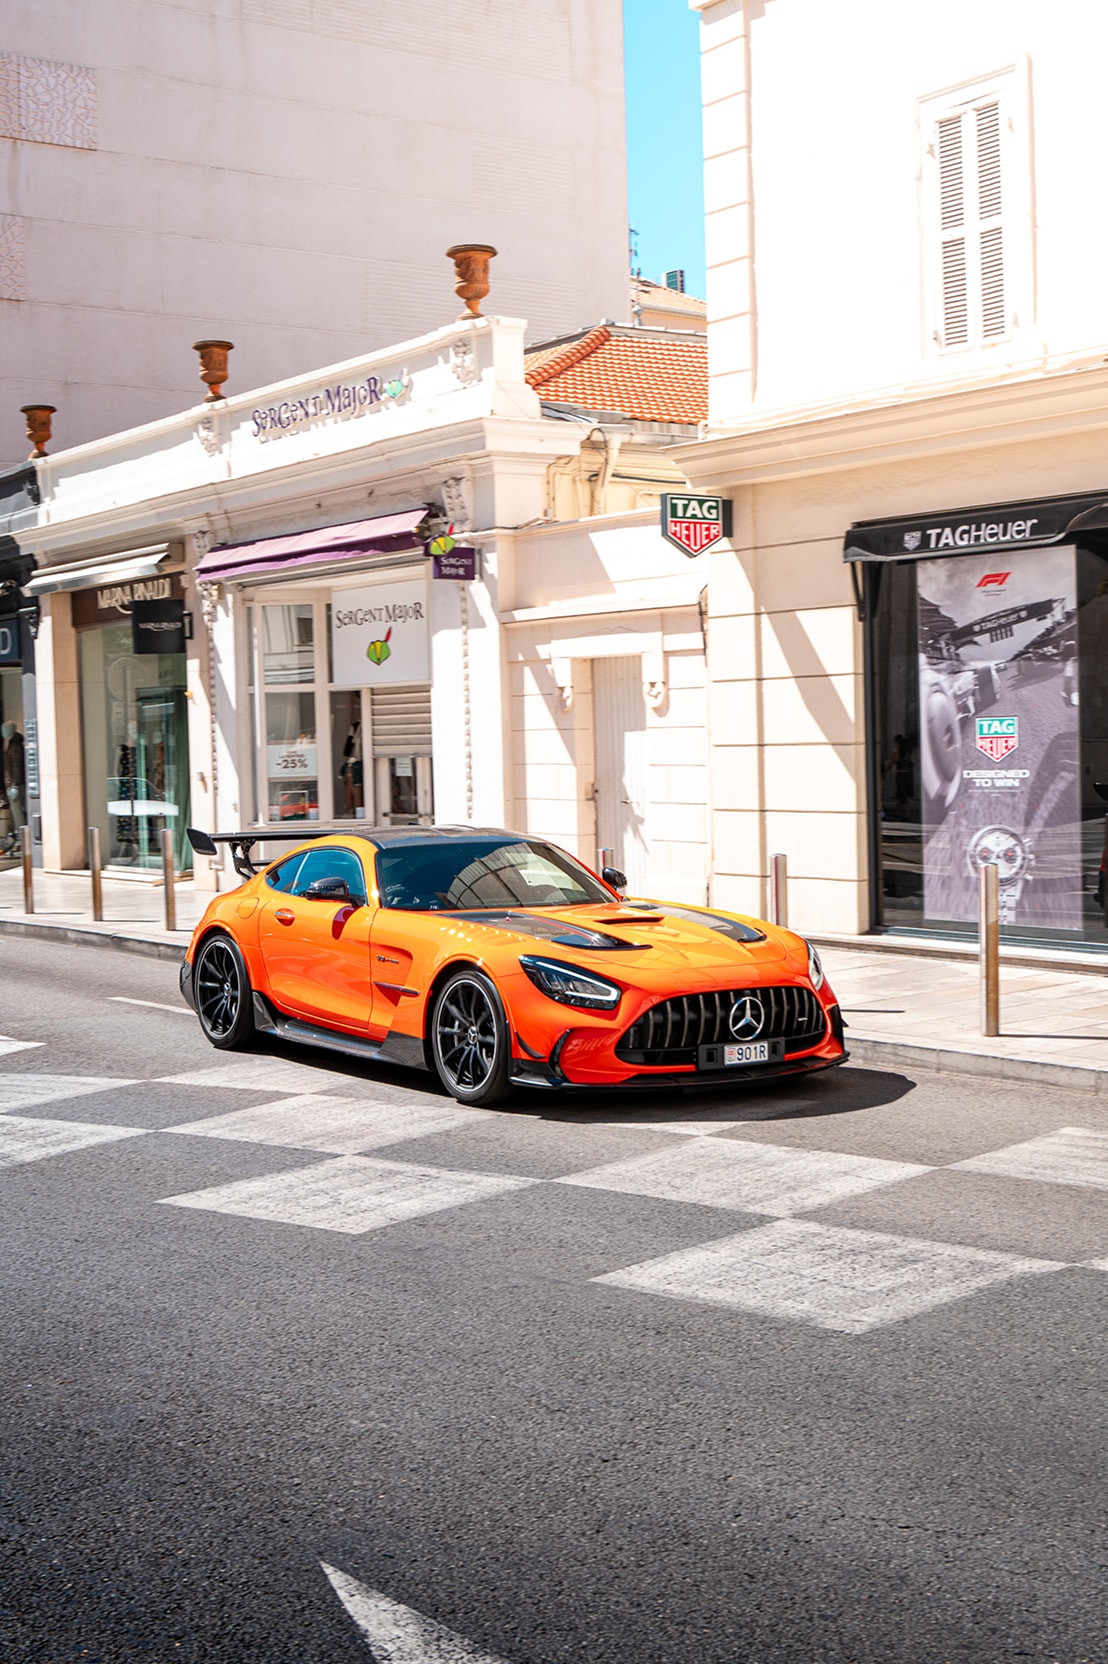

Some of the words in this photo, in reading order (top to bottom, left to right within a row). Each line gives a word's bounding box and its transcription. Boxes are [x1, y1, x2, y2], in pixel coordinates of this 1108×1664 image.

[671, 498, 718, 519] TAG
[670, 521, 720, 550] HEUER
[979, 719, 1015, 734] TAG
[979, 737, 1015, 758] HEUER
[276, 758, 309, 769] -25%
[962, 769, 1030, 778] DESIGNED
[972, 778, 992, 787] TO
[993, 778, 1020, 787] WIN
[736, 1044, 766, 1062] 901R
